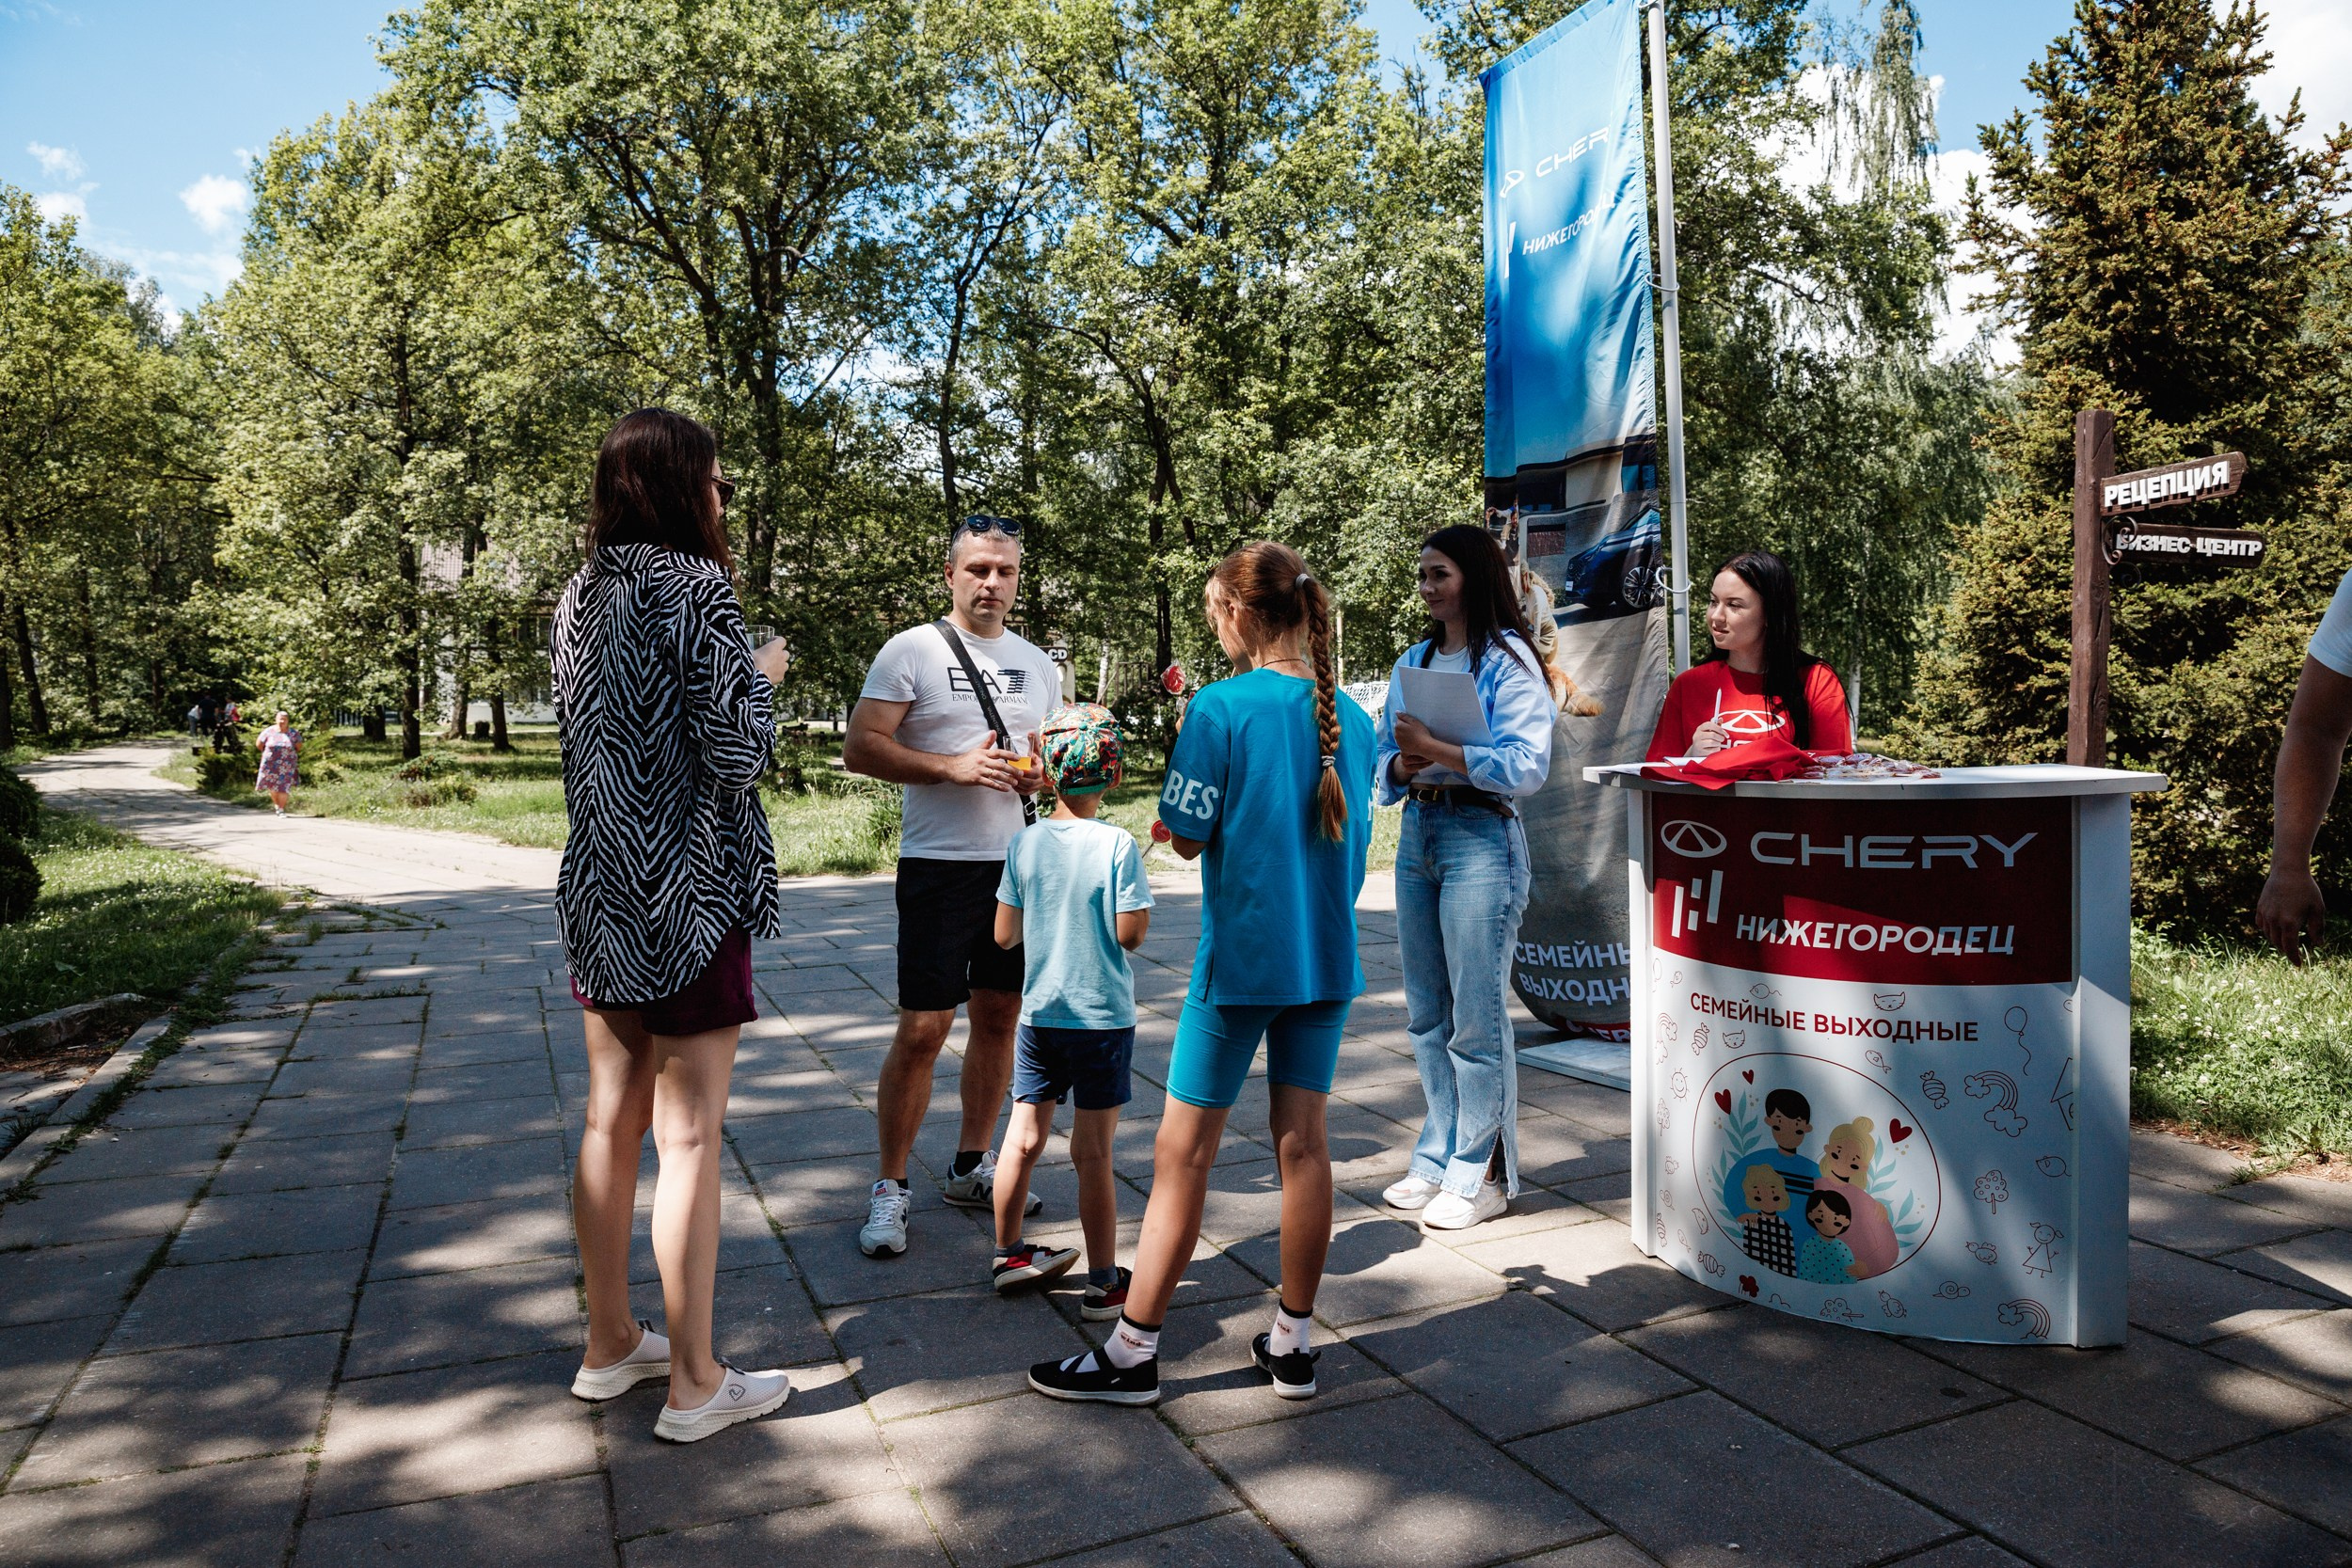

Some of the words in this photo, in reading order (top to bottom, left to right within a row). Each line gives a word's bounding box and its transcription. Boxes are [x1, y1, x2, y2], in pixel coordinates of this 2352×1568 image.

[1535, 124, 1611, 178] CHER
[2104, 461, 2230, 508] РЕЦЕПЦИЯ
[1162, 769, 1220, 820] BES
[1750, 831, 2039, 869] CHERY
[1514, 940, 1630, 968] СЕМЕЙН
[1736, 913, 2015, 957] НИЖЕГОРОДЕЦ
[1518, 972, 1630, 1006] ВЫХОДН
[1690, 992, 1806, 1031] СЕМЕЙНЫЕ
[1814, 1013, 1979, 1044] ВЫХОДНЫЕ
